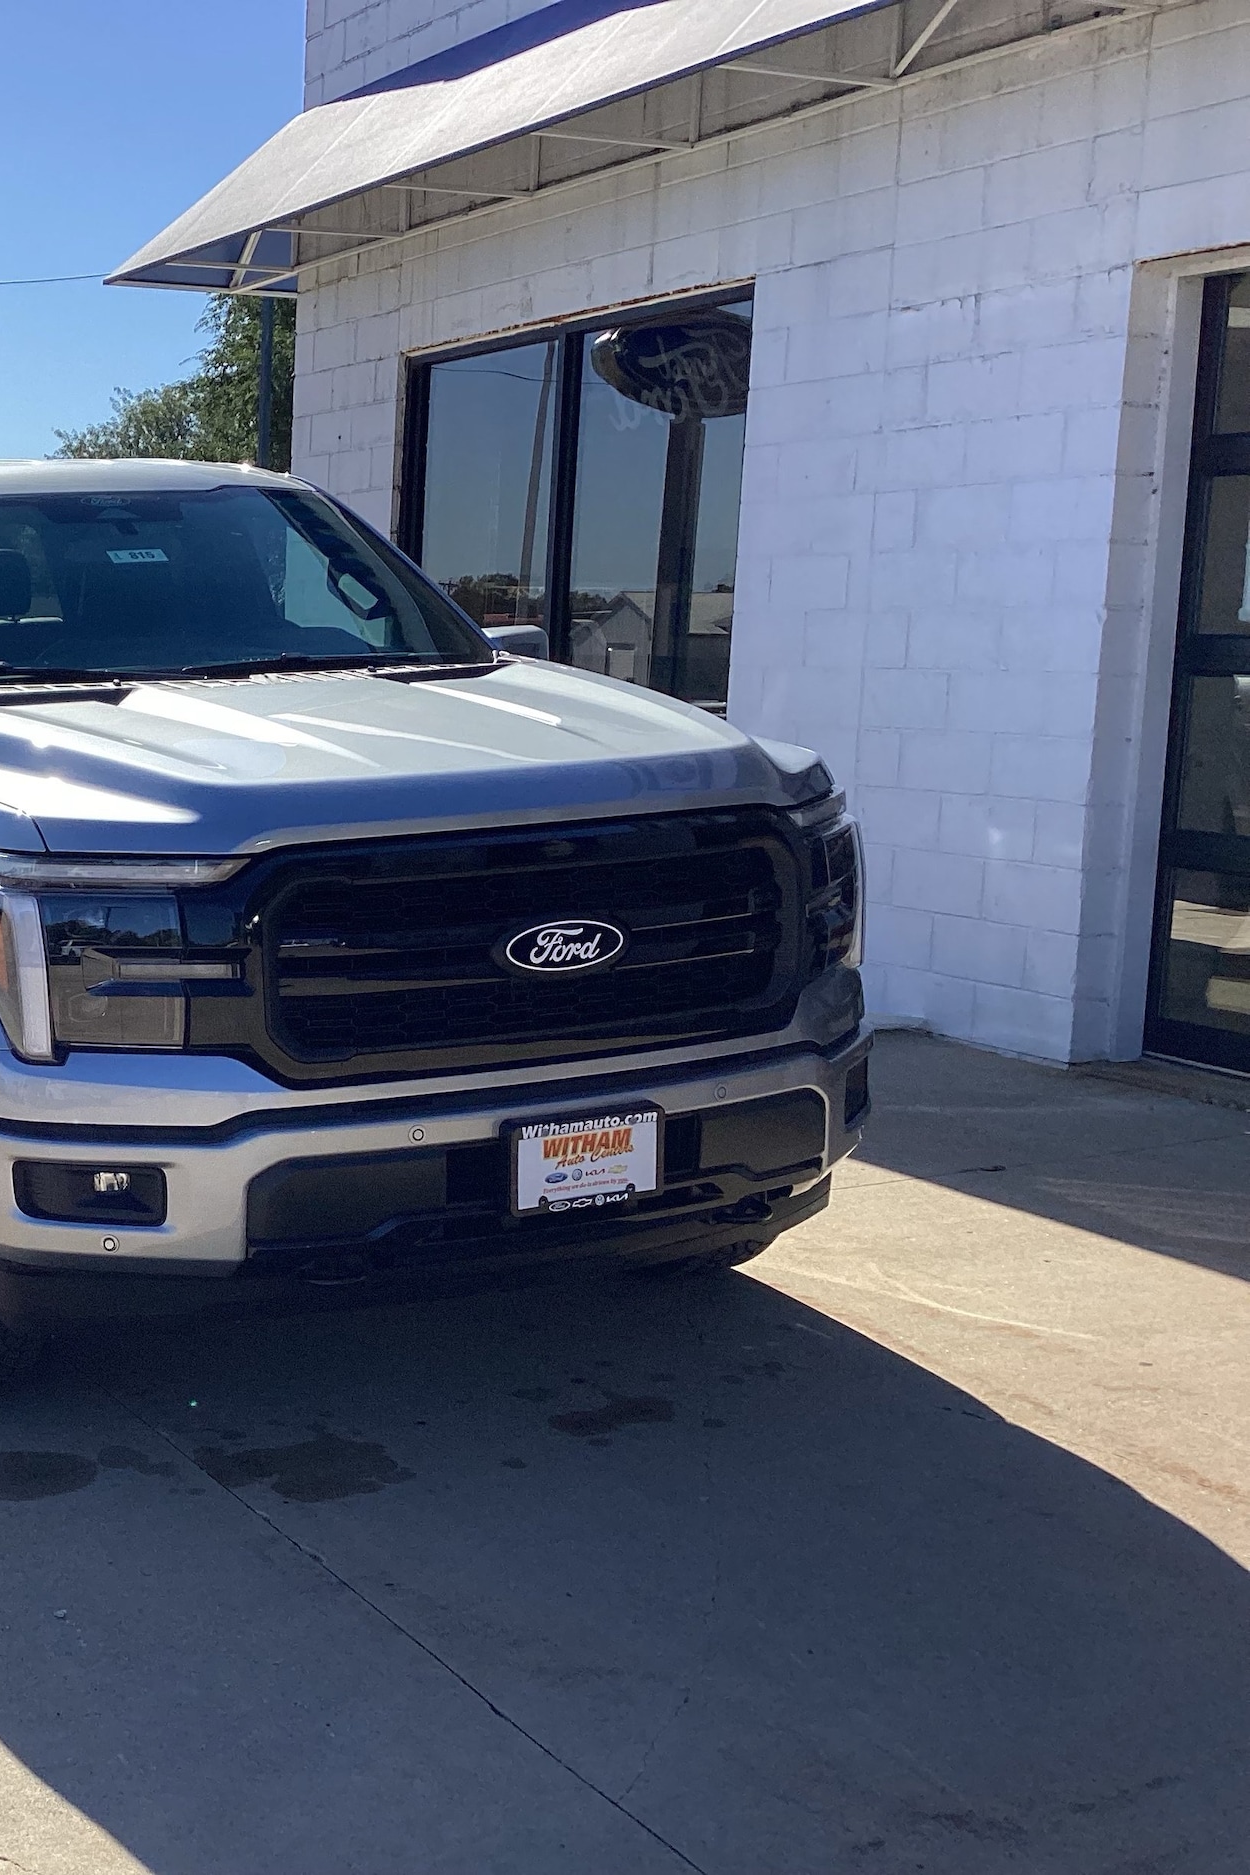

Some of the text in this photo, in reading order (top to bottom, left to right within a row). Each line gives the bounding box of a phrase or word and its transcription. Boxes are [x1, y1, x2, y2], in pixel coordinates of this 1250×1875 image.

[530, 927, 602, 964] Ford
[522, 1111, 658, 1140] Withamauto.com
[543, 1127, 633, 1160] WITHAM
[555, 1154, 585, 1170] Auto
